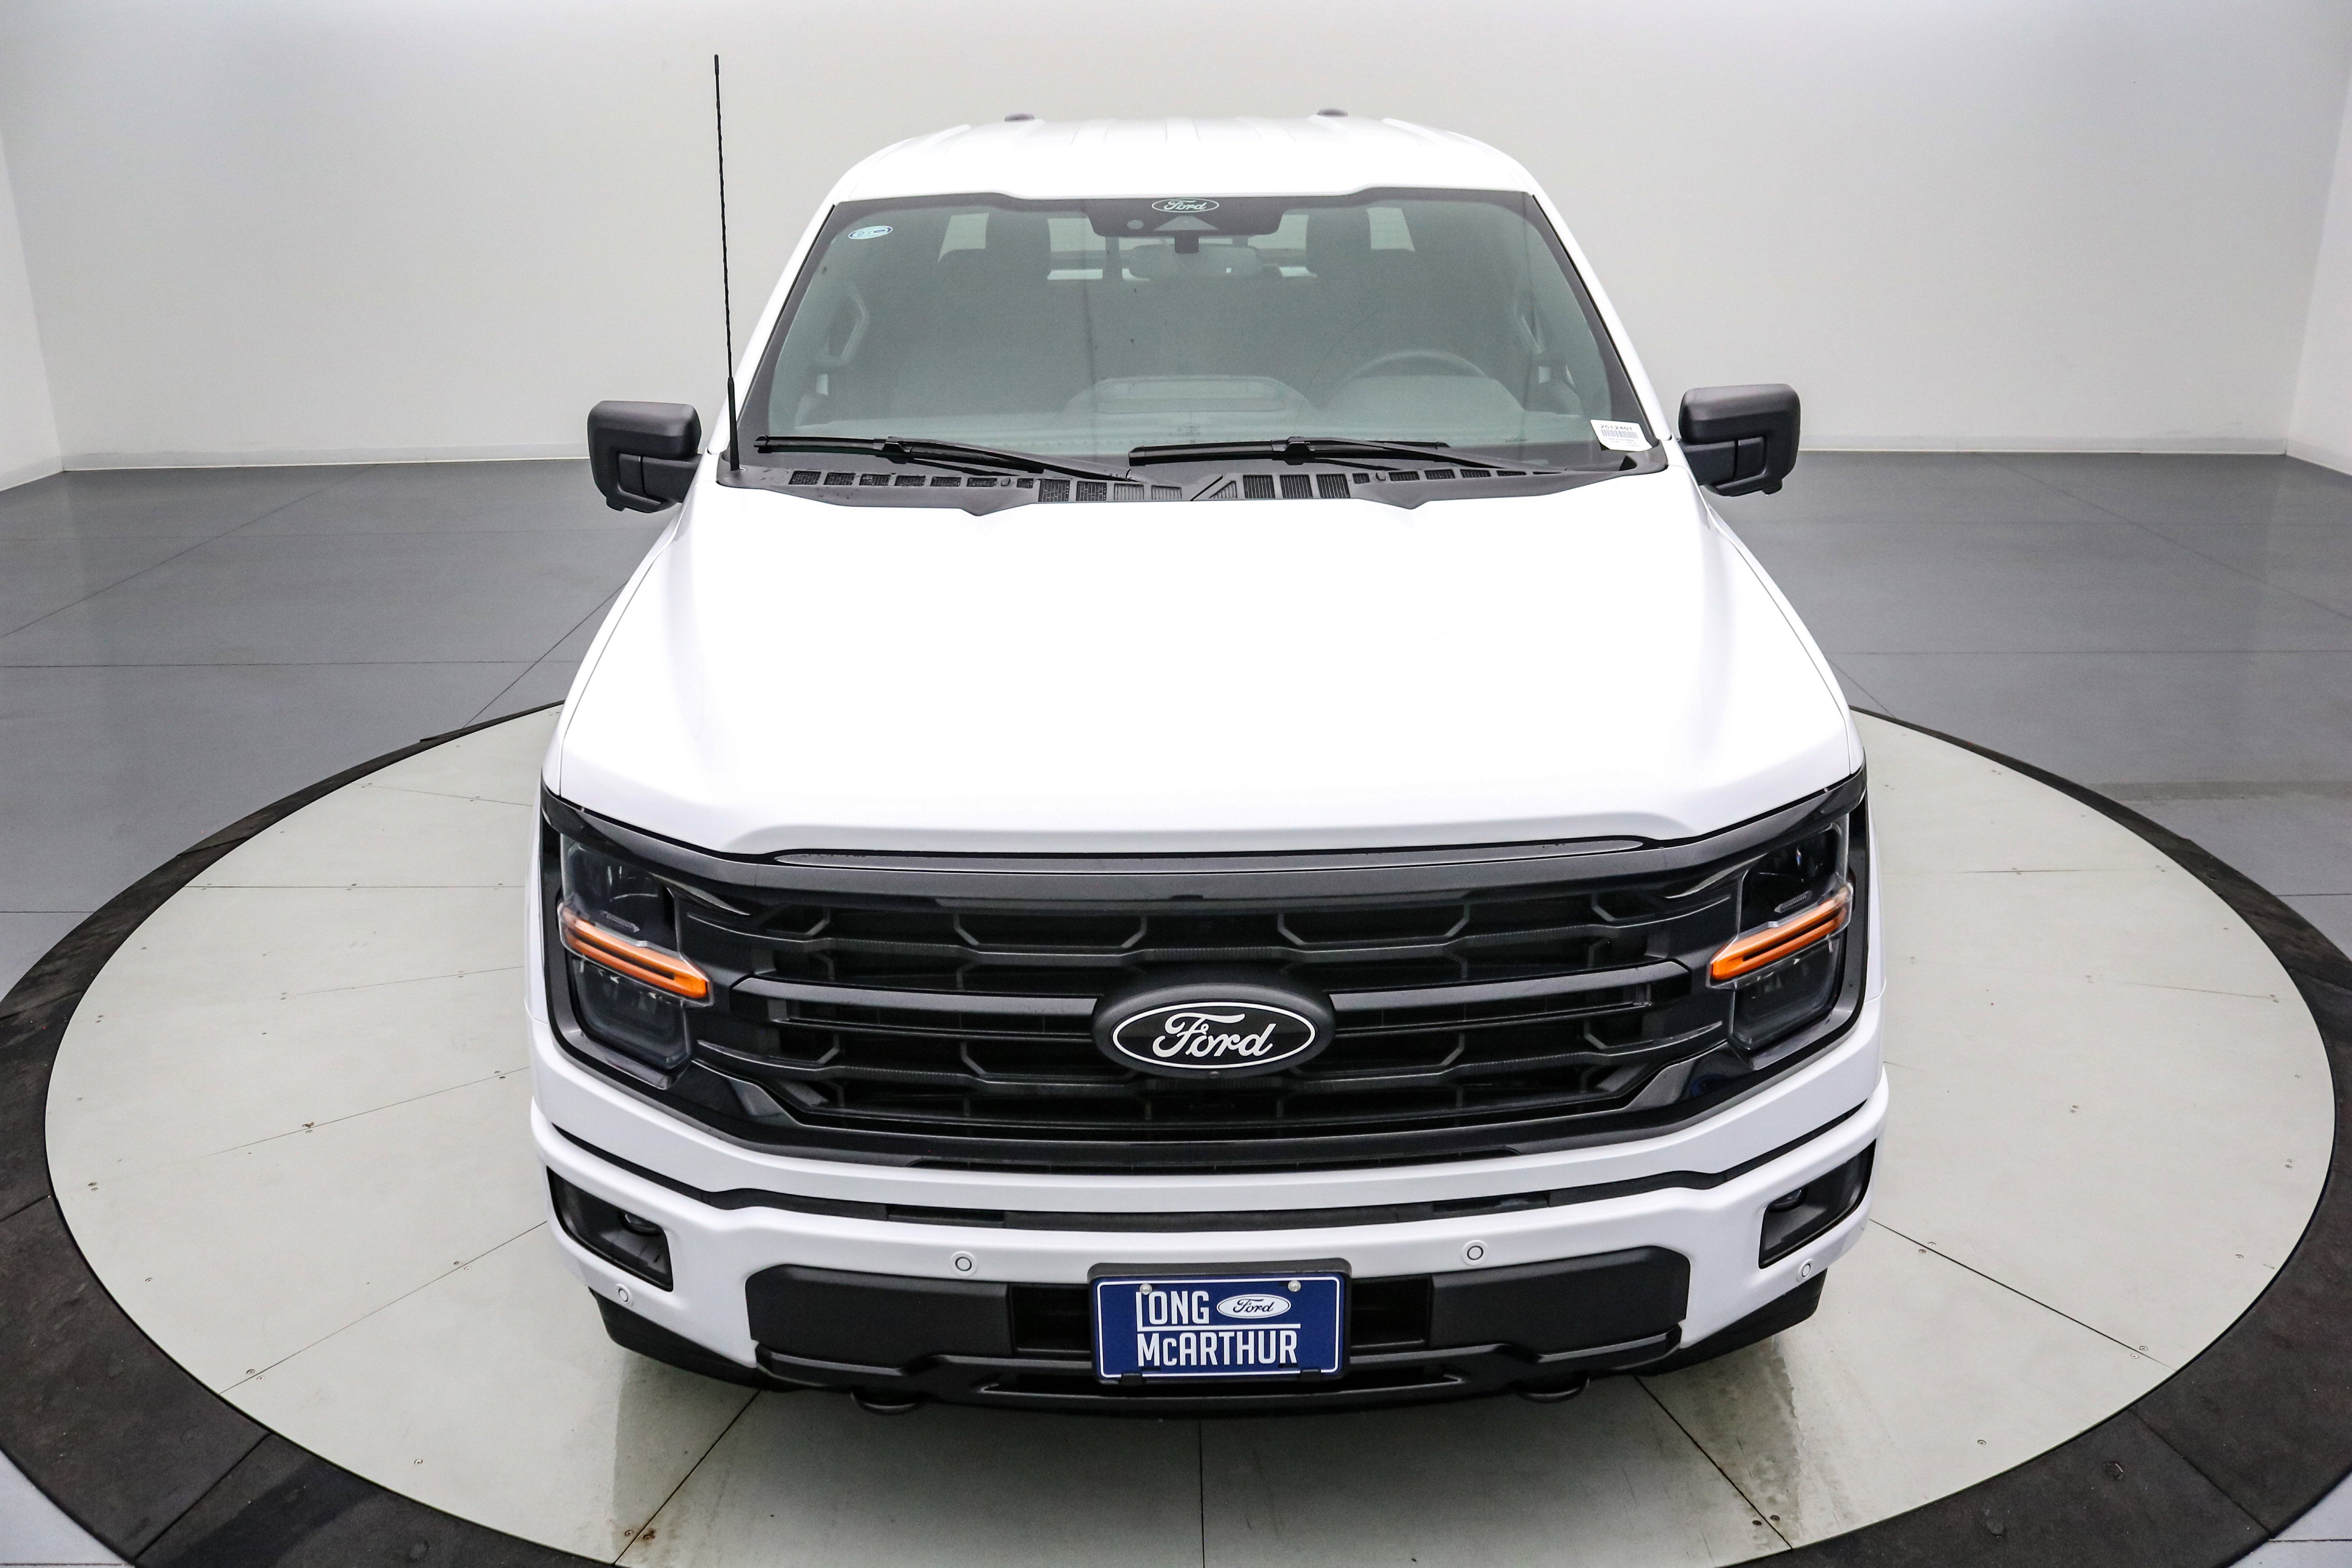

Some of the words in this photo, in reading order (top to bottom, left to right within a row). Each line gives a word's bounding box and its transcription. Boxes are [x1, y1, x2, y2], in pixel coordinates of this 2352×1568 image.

[1164, 200, 1207, 210] Ford
[1152, 1012, 1276, 1058] Ford
[1136, 1291, 1209, 1332] LONG
[1232, 1298, 1274, 1313] Ford
